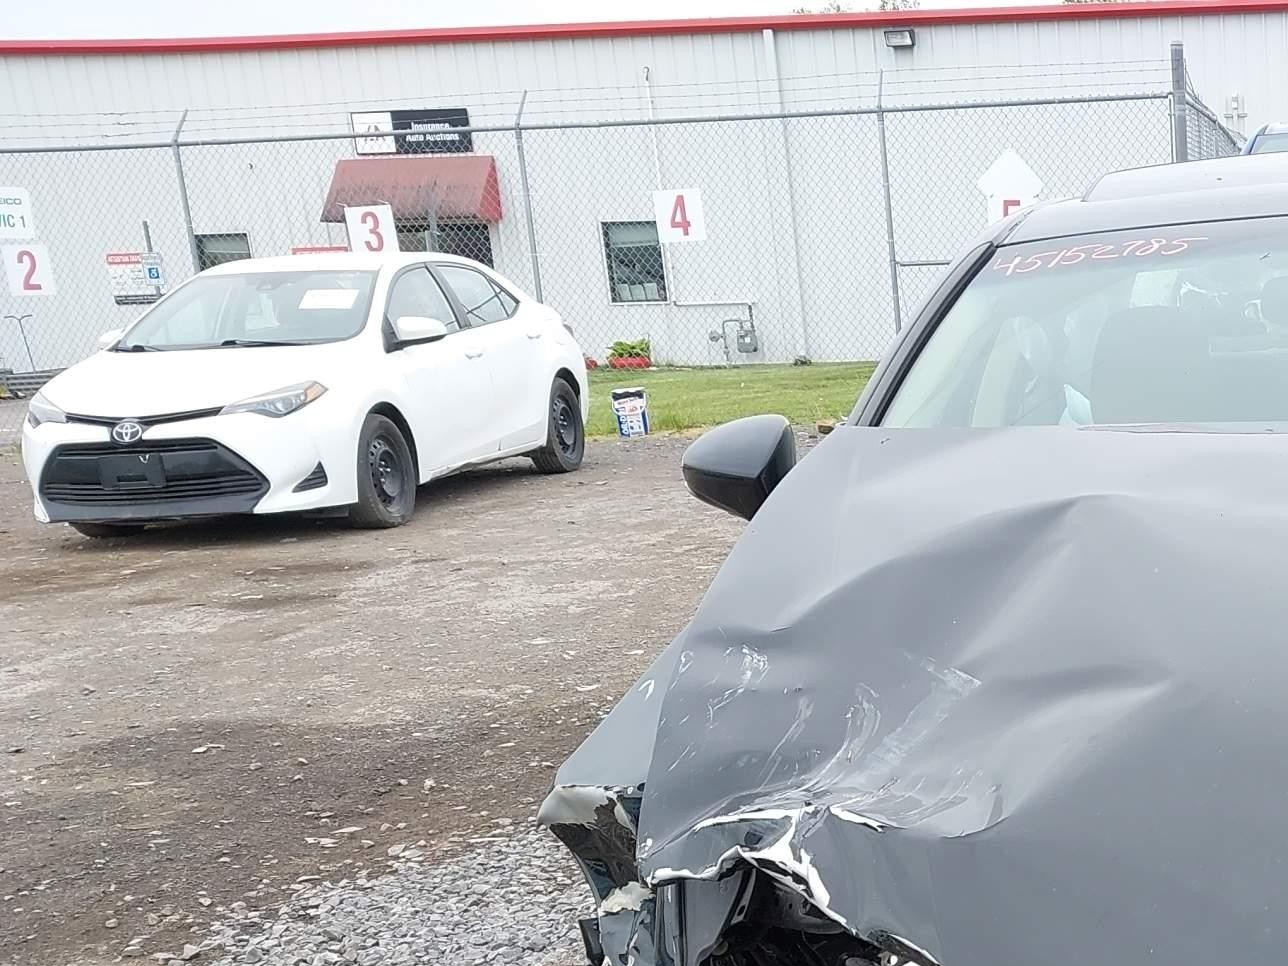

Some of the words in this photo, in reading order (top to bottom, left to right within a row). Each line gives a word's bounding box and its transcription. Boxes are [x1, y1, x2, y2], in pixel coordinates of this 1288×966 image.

[360, 211, 384, 252] 3
[670, 194, 691, 236] 4
[16, 250, 42, 290] 2
[993, 236, 1209, 277] 45152785
